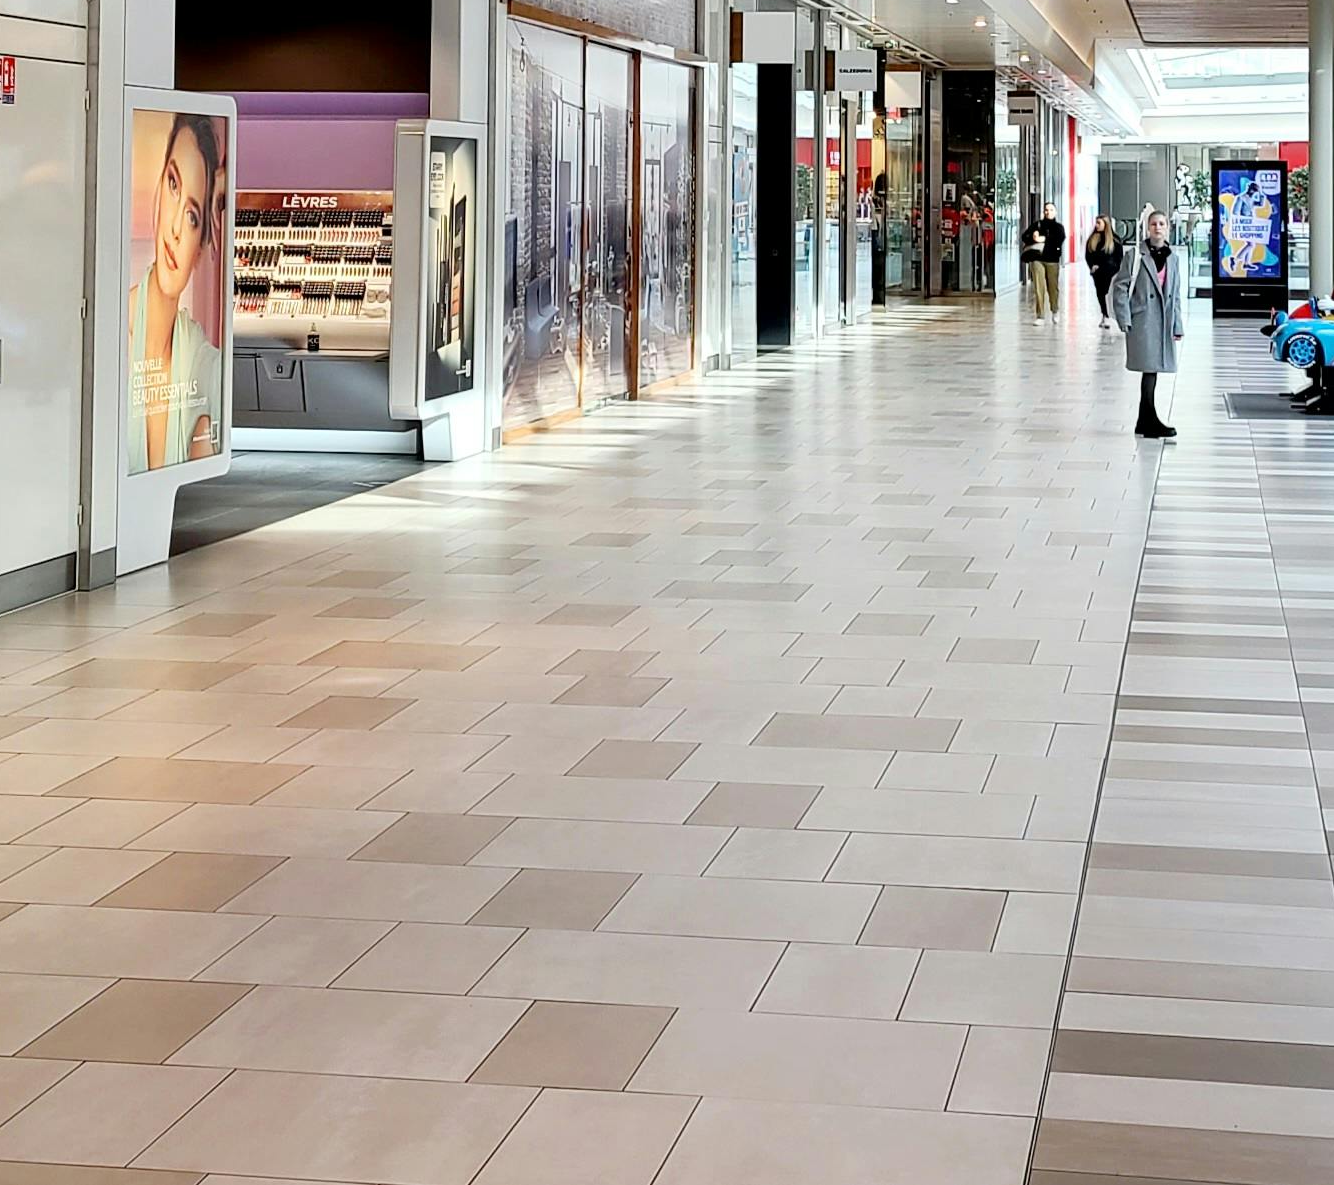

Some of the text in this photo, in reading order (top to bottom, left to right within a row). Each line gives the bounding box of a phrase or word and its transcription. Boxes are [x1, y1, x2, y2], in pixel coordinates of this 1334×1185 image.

[282, 193, 338, 209] LÈVRES
[132, 379, 198, 406] BEAUTY ESSENTIALS
